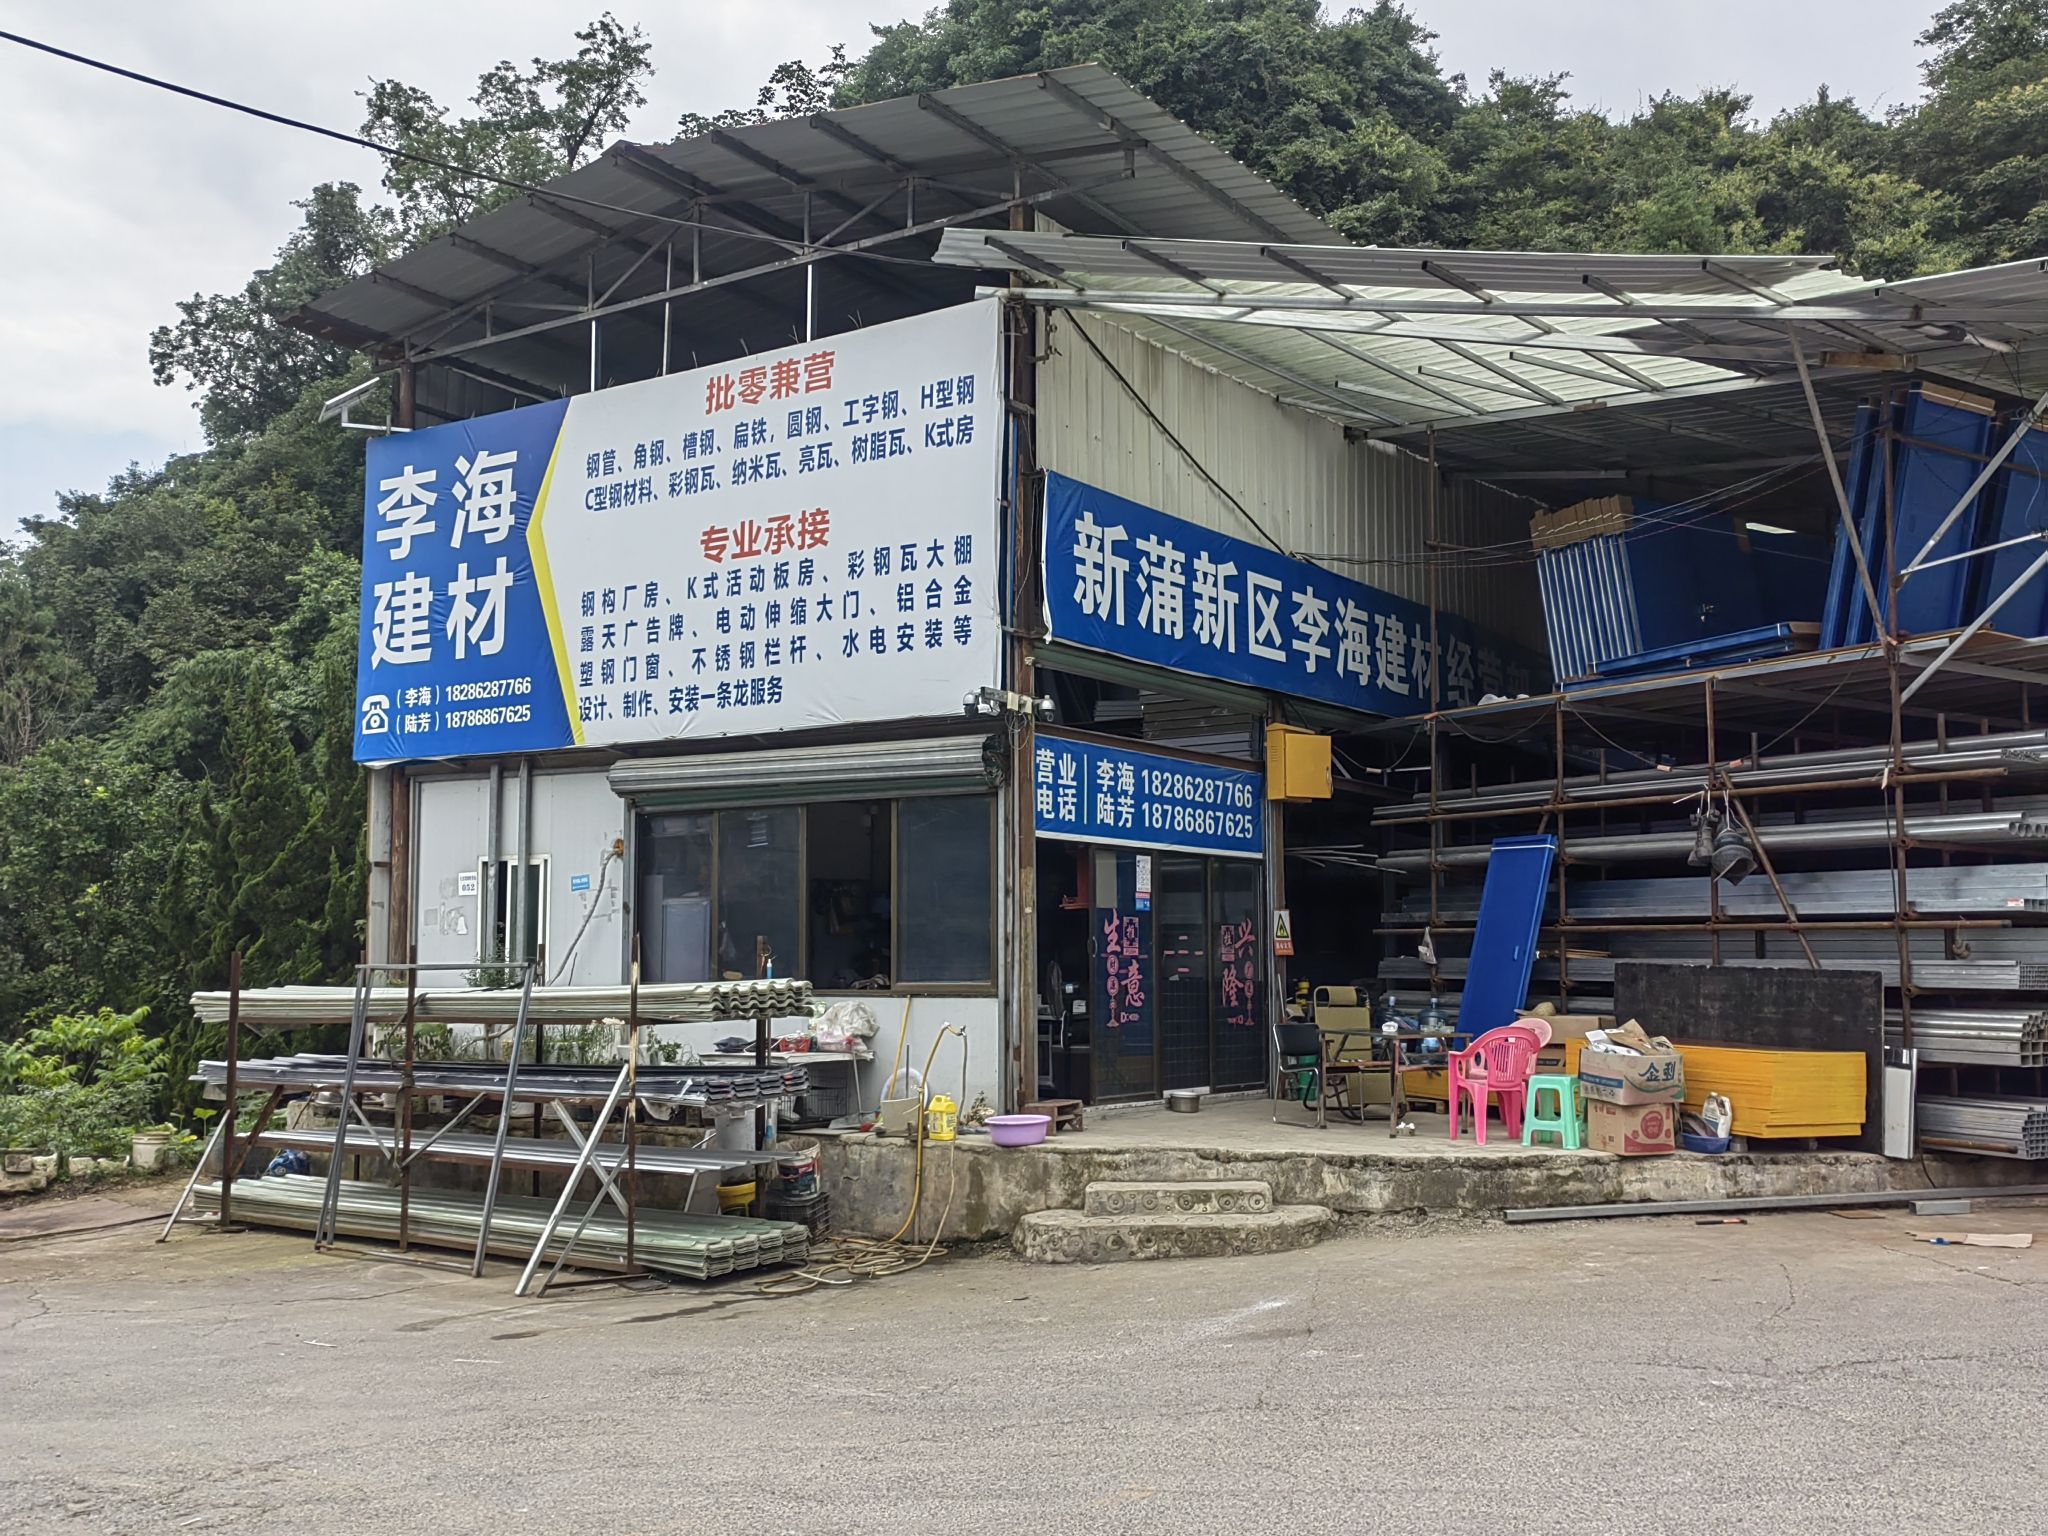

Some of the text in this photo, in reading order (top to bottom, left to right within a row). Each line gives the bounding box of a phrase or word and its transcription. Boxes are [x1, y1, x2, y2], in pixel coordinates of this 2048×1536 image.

[705, 350, 836, 415] 批零兼营
[376, 450, 520, 560] 李海
[699, 507, 831, 564] 专业承接
[371, 556, 514, 670] 建材
[445, 677, 532, 702] 18286287766
[445, 704, 531, 730] 18786867625
[1036, 748, 1077, 787] 营业
[1096, 758, 1253, 809] 李海 18286287766
[1036, 785, 1077, 822] 电话
[1096, 793, 1253, 839] 陆芳 18786867625
